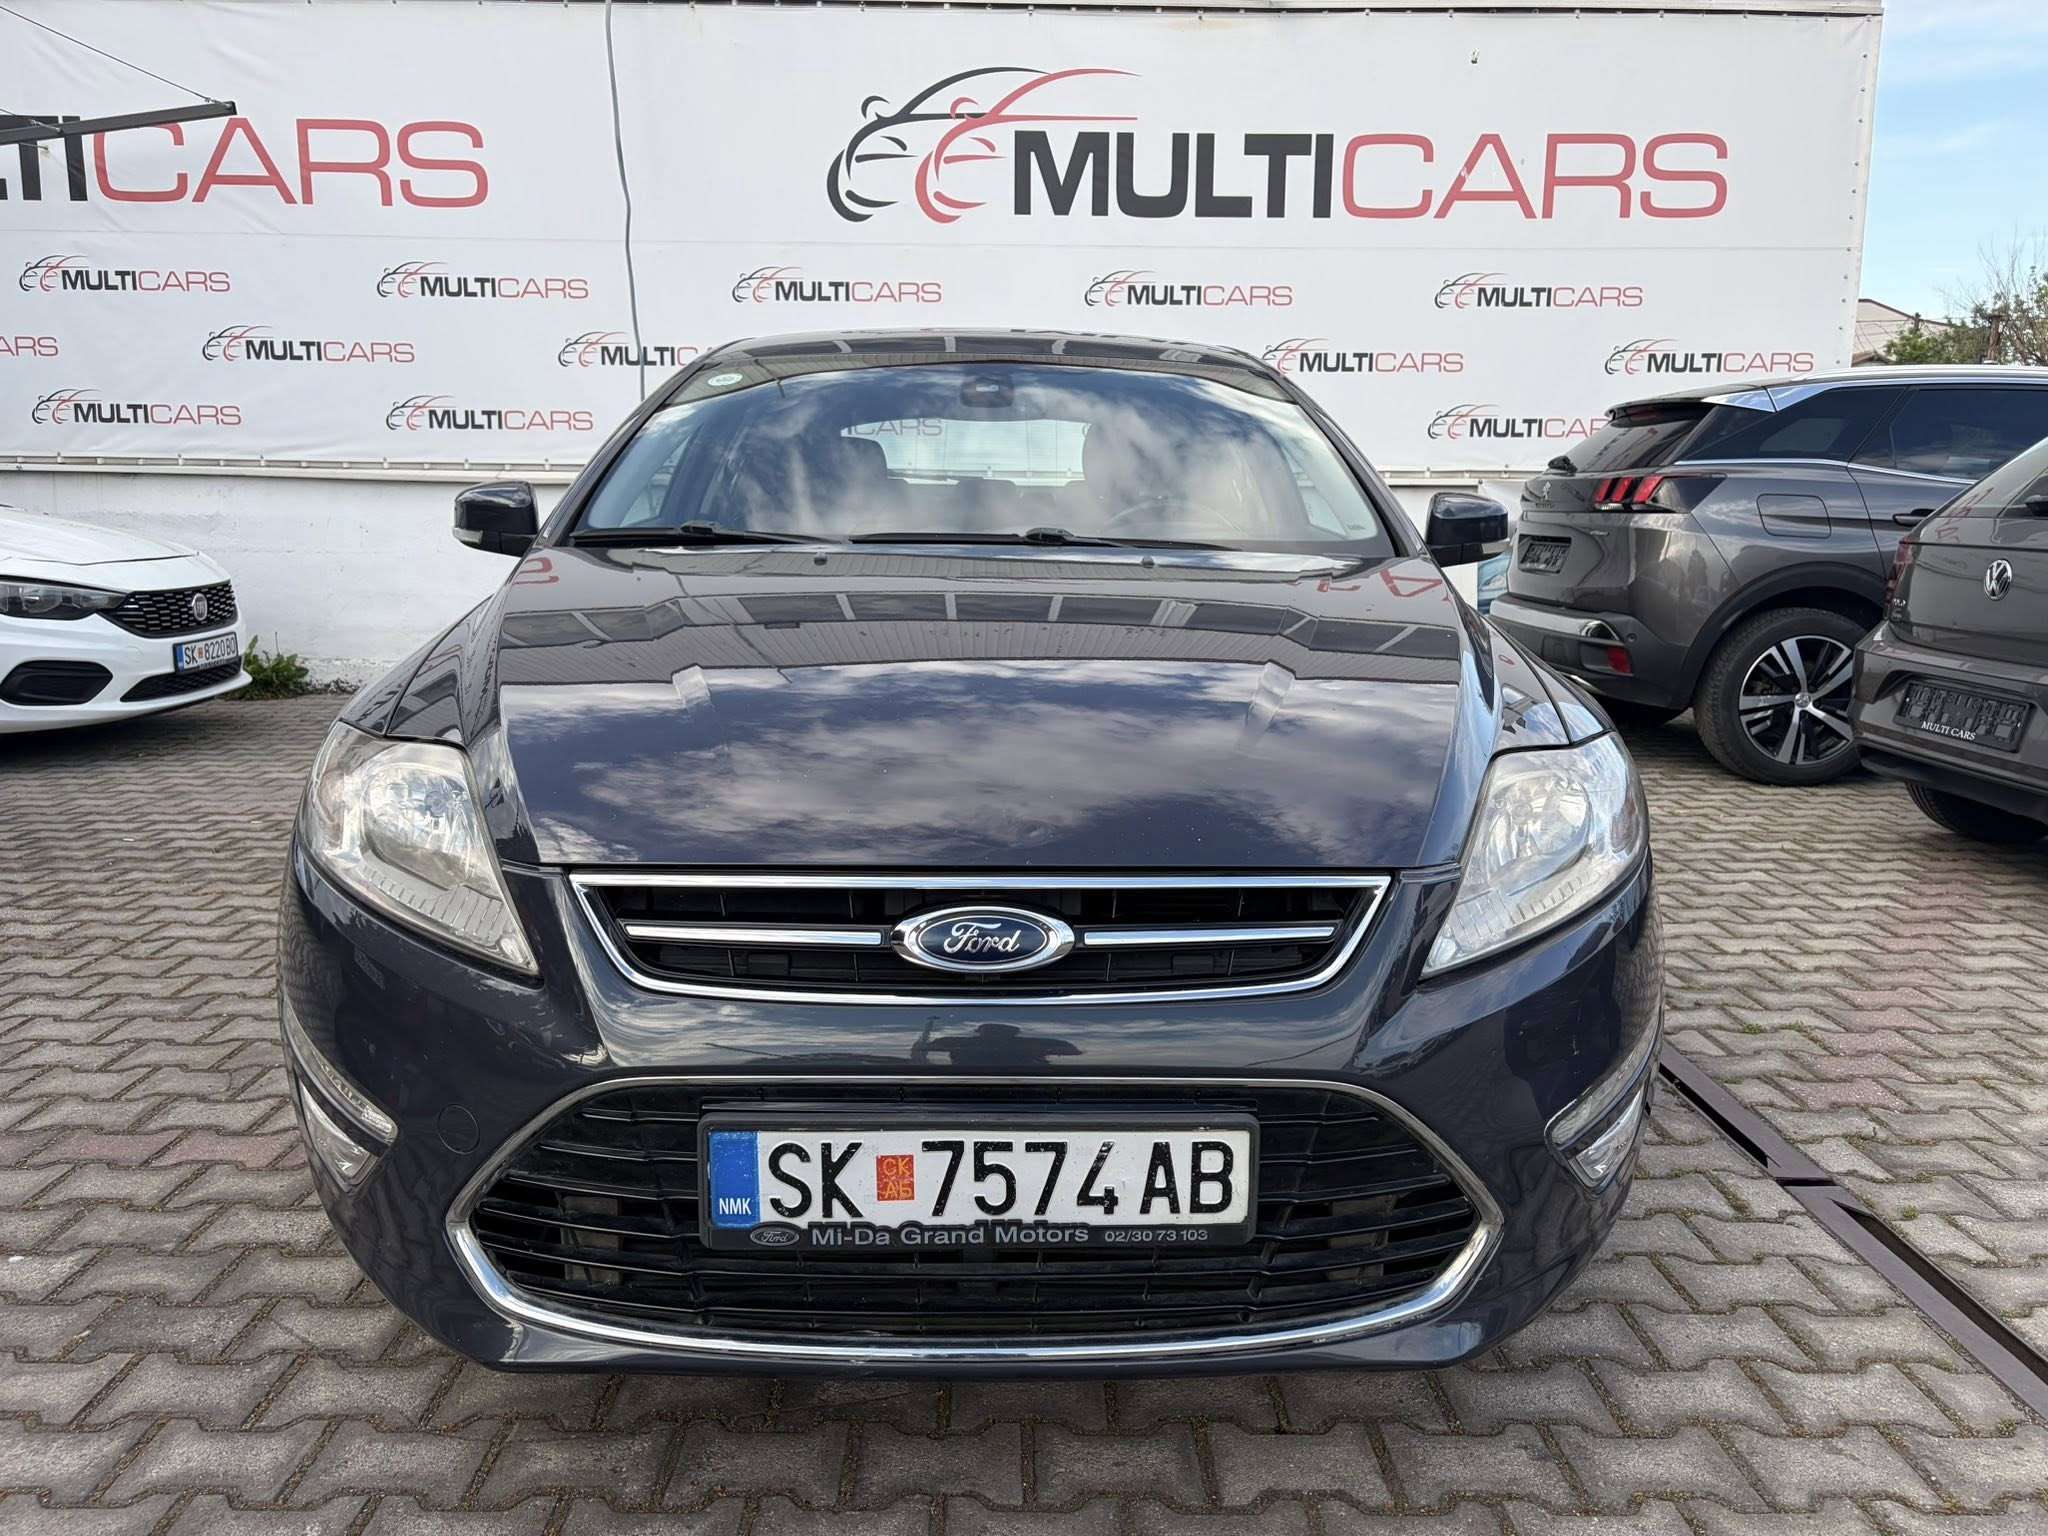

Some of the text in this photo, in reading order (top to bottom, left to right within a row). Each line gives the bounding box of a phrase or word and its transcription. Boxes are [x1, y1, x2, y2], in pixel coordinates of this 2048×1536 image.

[1013, 129, 1728, 220] MULTICARS
[61, 268, 231, 293] MULTICARS
[419, 274, 589, 300] MULTICARS
[774, 279, 942, 303] MULTICARS
[1126, 283, 1293, 307] MULTICARS
[1476, 284, 1644, 308] MULTICARS
[244, 338, 415, 363] MULTICARS
[1298, 349, 1465, 374] MULTICARS
[1645, 350, 1815, 374] MULTICARS
[73, 401, 242, 426] MULTICARS
[427, 408, 594, 431] MULTICARS
[184, 645, 198, 665] SK
[204, 639, 226, 661] 8220
[1921, 721, 1976, 741] MULTI CARS
[943, 921, 1022, 954] Ford
[767, 1140, 1235, 1219] SK 7574 AB
[719, 1198, 752, 1215] NMK
[760, 1230, 789, 1243] Ford
[811, 1225, 1208, 1246] Mi-Da Grand Motors 02/30 73 103
